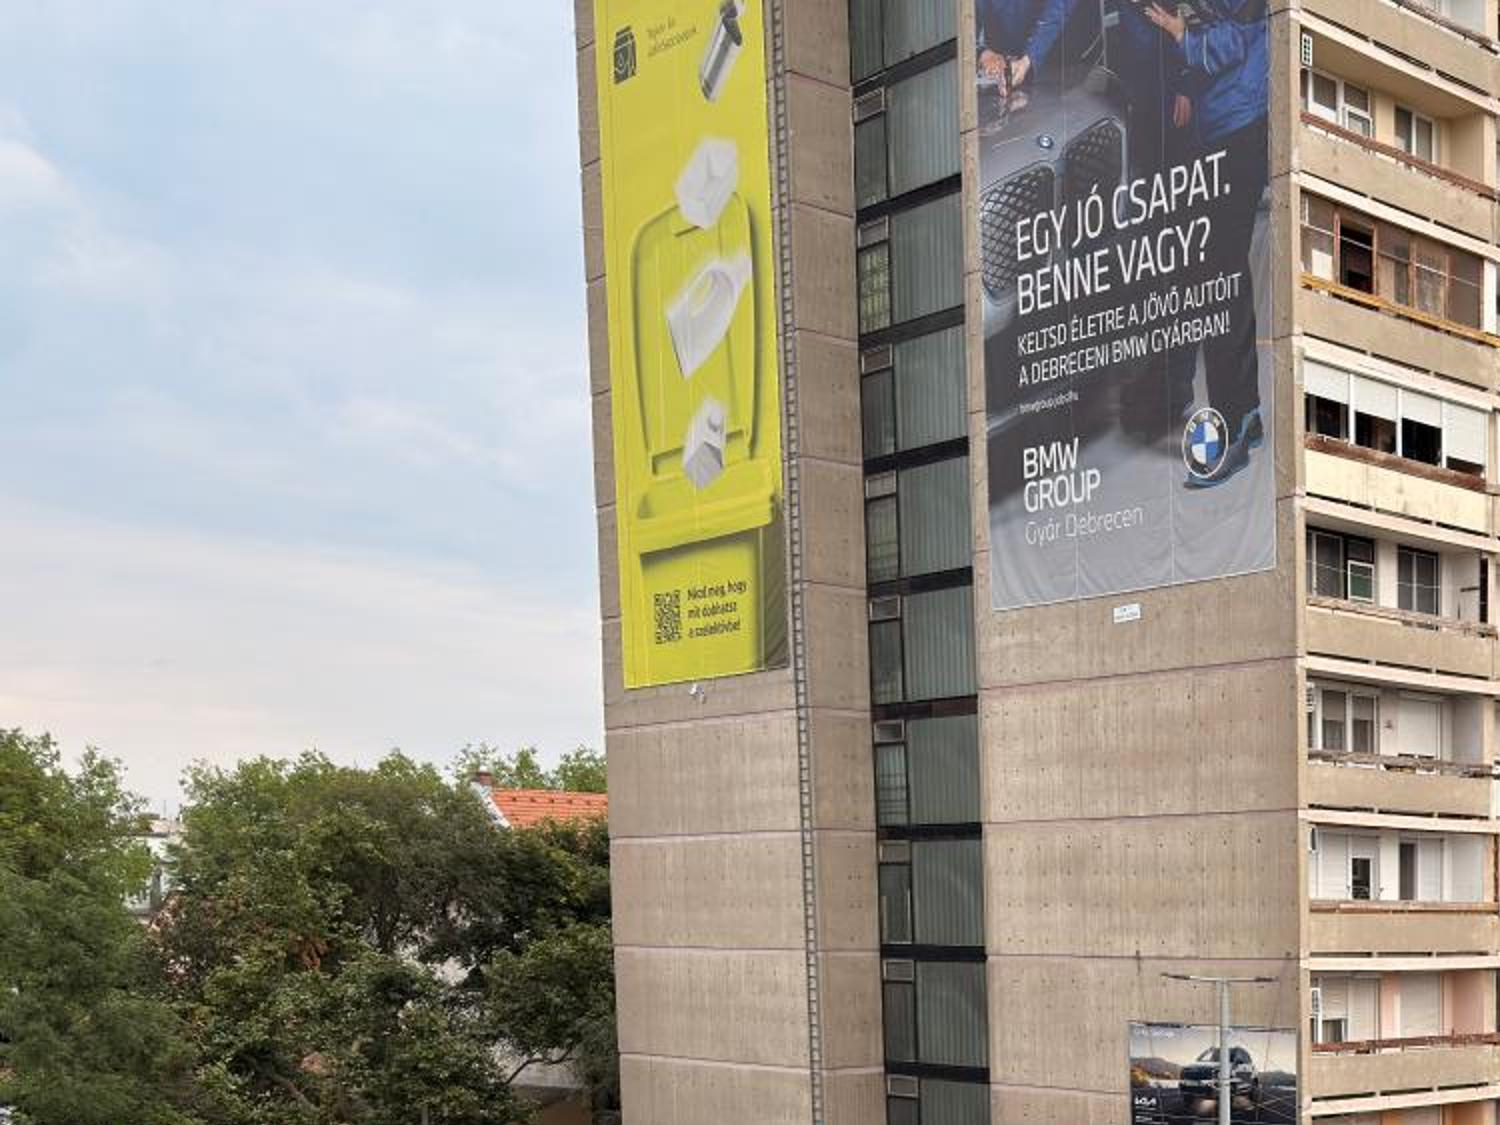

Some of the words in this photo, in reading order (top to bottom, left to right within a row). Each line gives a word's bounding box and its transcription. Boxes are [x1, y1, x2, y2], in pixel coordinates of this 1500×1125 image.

[1016, 205, 1067, 262] EGY
[1072, 183, 1103, 248] JÓ
[1112, 150, 1231, 230] CSAPAT.
[1017, 248, 1111, 316] BENNE
[1117, 216, 1211, 284] VAGY?
[1017, 322, 1067, 357] KELTSD
[1071, 314, 1125, 343] ÉLETRE
[1127, 303, 1139, 326] A
[1183, 272, 1242, 311] AUTÓIT
[1018, 364, 1029, 387] A
[1031, 347, 1110, 385] DEBRECENI
[1112, 334, 1149, 364] BMW
[1151, 310, 1231, 354] GYÁRBAN!
[1022, 437, 1079, 479] BMW
[1023, 468, 1101, 513] GROUP
[1025, 518, 1061, 547] Gyár
[1065, 506, 1144, 537] Debrecen
